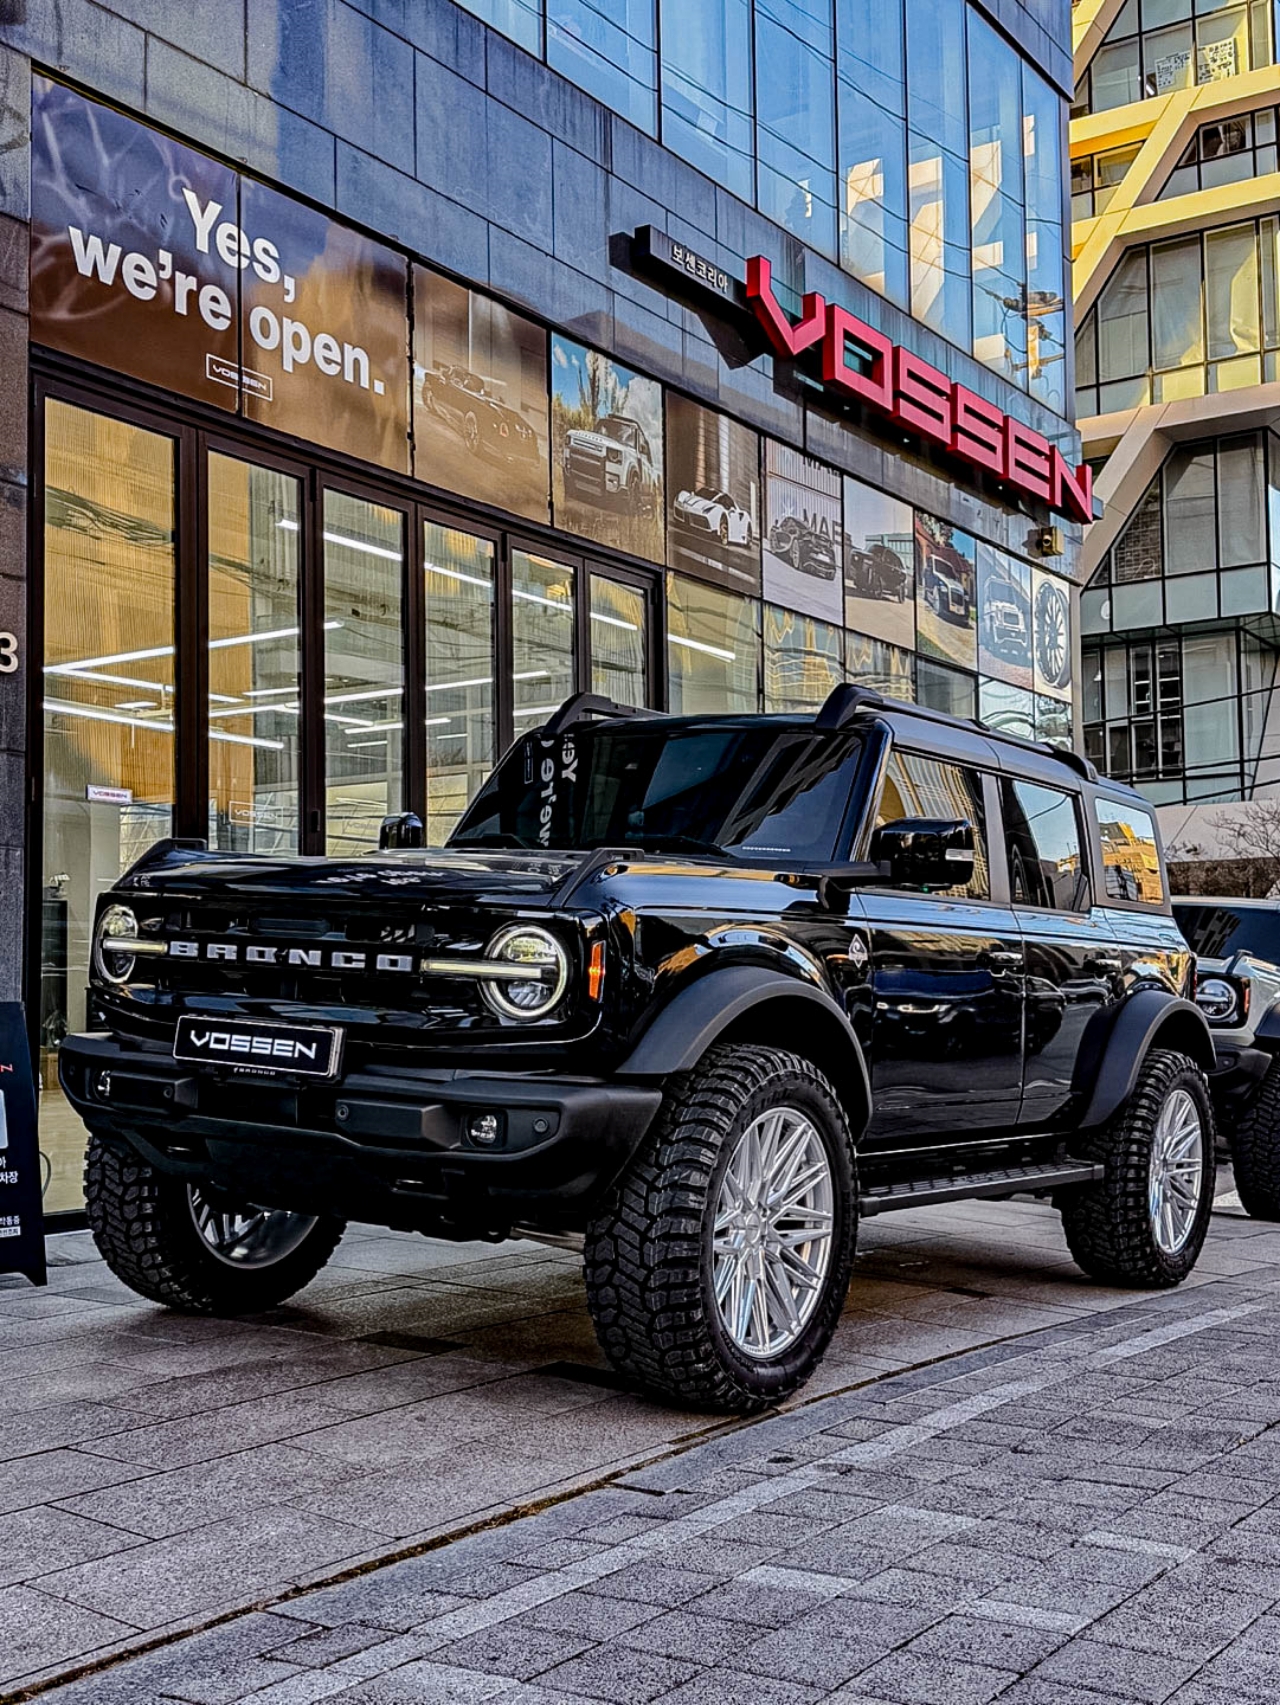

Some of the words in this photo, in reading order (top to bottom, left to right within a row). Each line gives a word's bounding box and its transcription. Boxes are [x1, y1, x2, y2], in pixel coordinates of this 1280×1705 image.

[182, 187, 296, 303] Yes,
[68, 225, 232, 331] we're
[249, 306, 385, 396] open.
[212, 364, 267, 391] VOSSEN
[746, 254, 1094, 525] VOSSEN
[169, 941, 413, 972] BRONCO
[190, 1029, 317, 1060] VOSSEN
